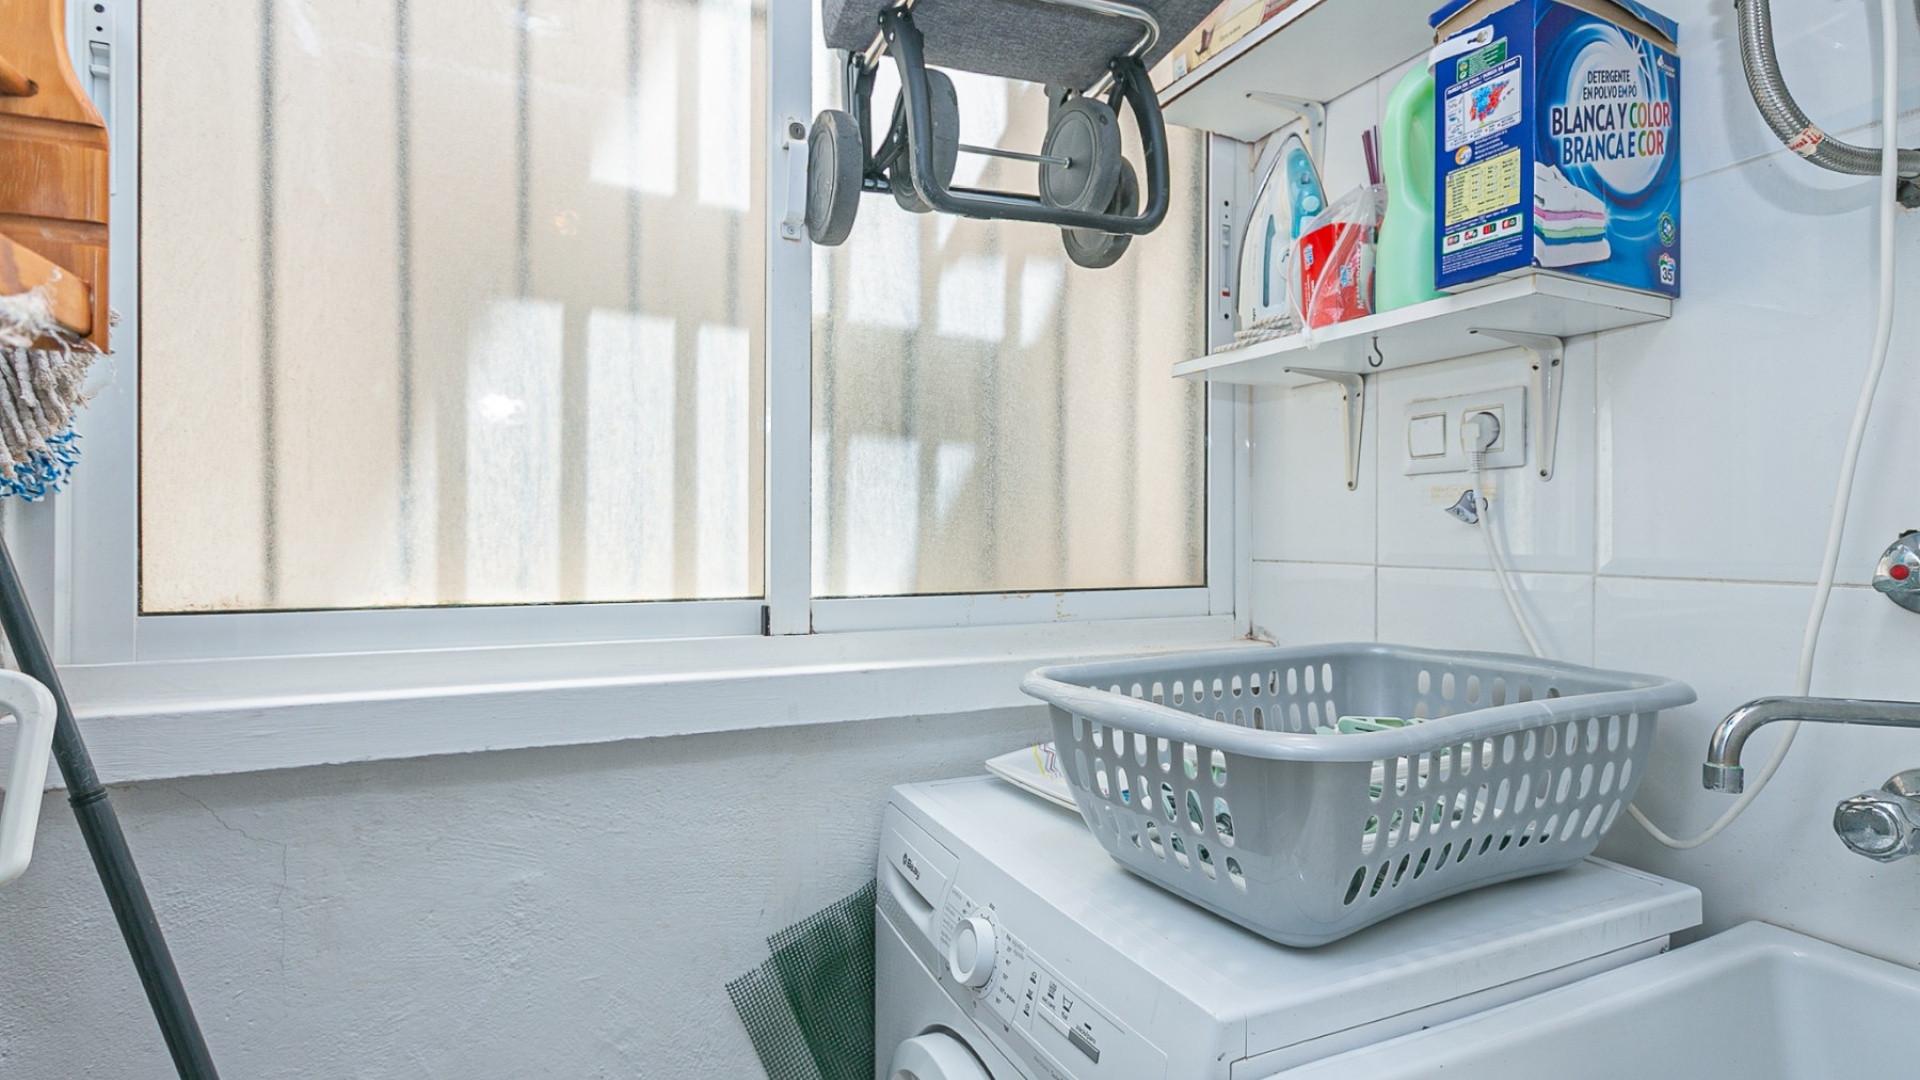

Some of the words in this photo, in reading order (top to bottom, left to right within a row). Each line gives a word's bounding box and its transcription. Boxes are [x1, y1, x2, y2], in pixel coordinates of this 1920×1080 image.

[1587, 69, 1631, 84] DETERGENTE
[1583, 86, 1593, 100] EN
[1594, 85, 1617, 100] POLVO
[1618, 85, 1627, 98] EM
[1628, 81, 1638, 98] PÓ
[1552, 103, 1615, 136] BLANCA
[1617, 102, 1628, 129] Y
[1629, 101, 1671, 129] COLOR
[1563, 132, 1625, 165] BRANCA
[1628, 131, 1636, 158] E
[1638, 129, 1664, 157] COR
[1662, 267, 1673, 282] 35
